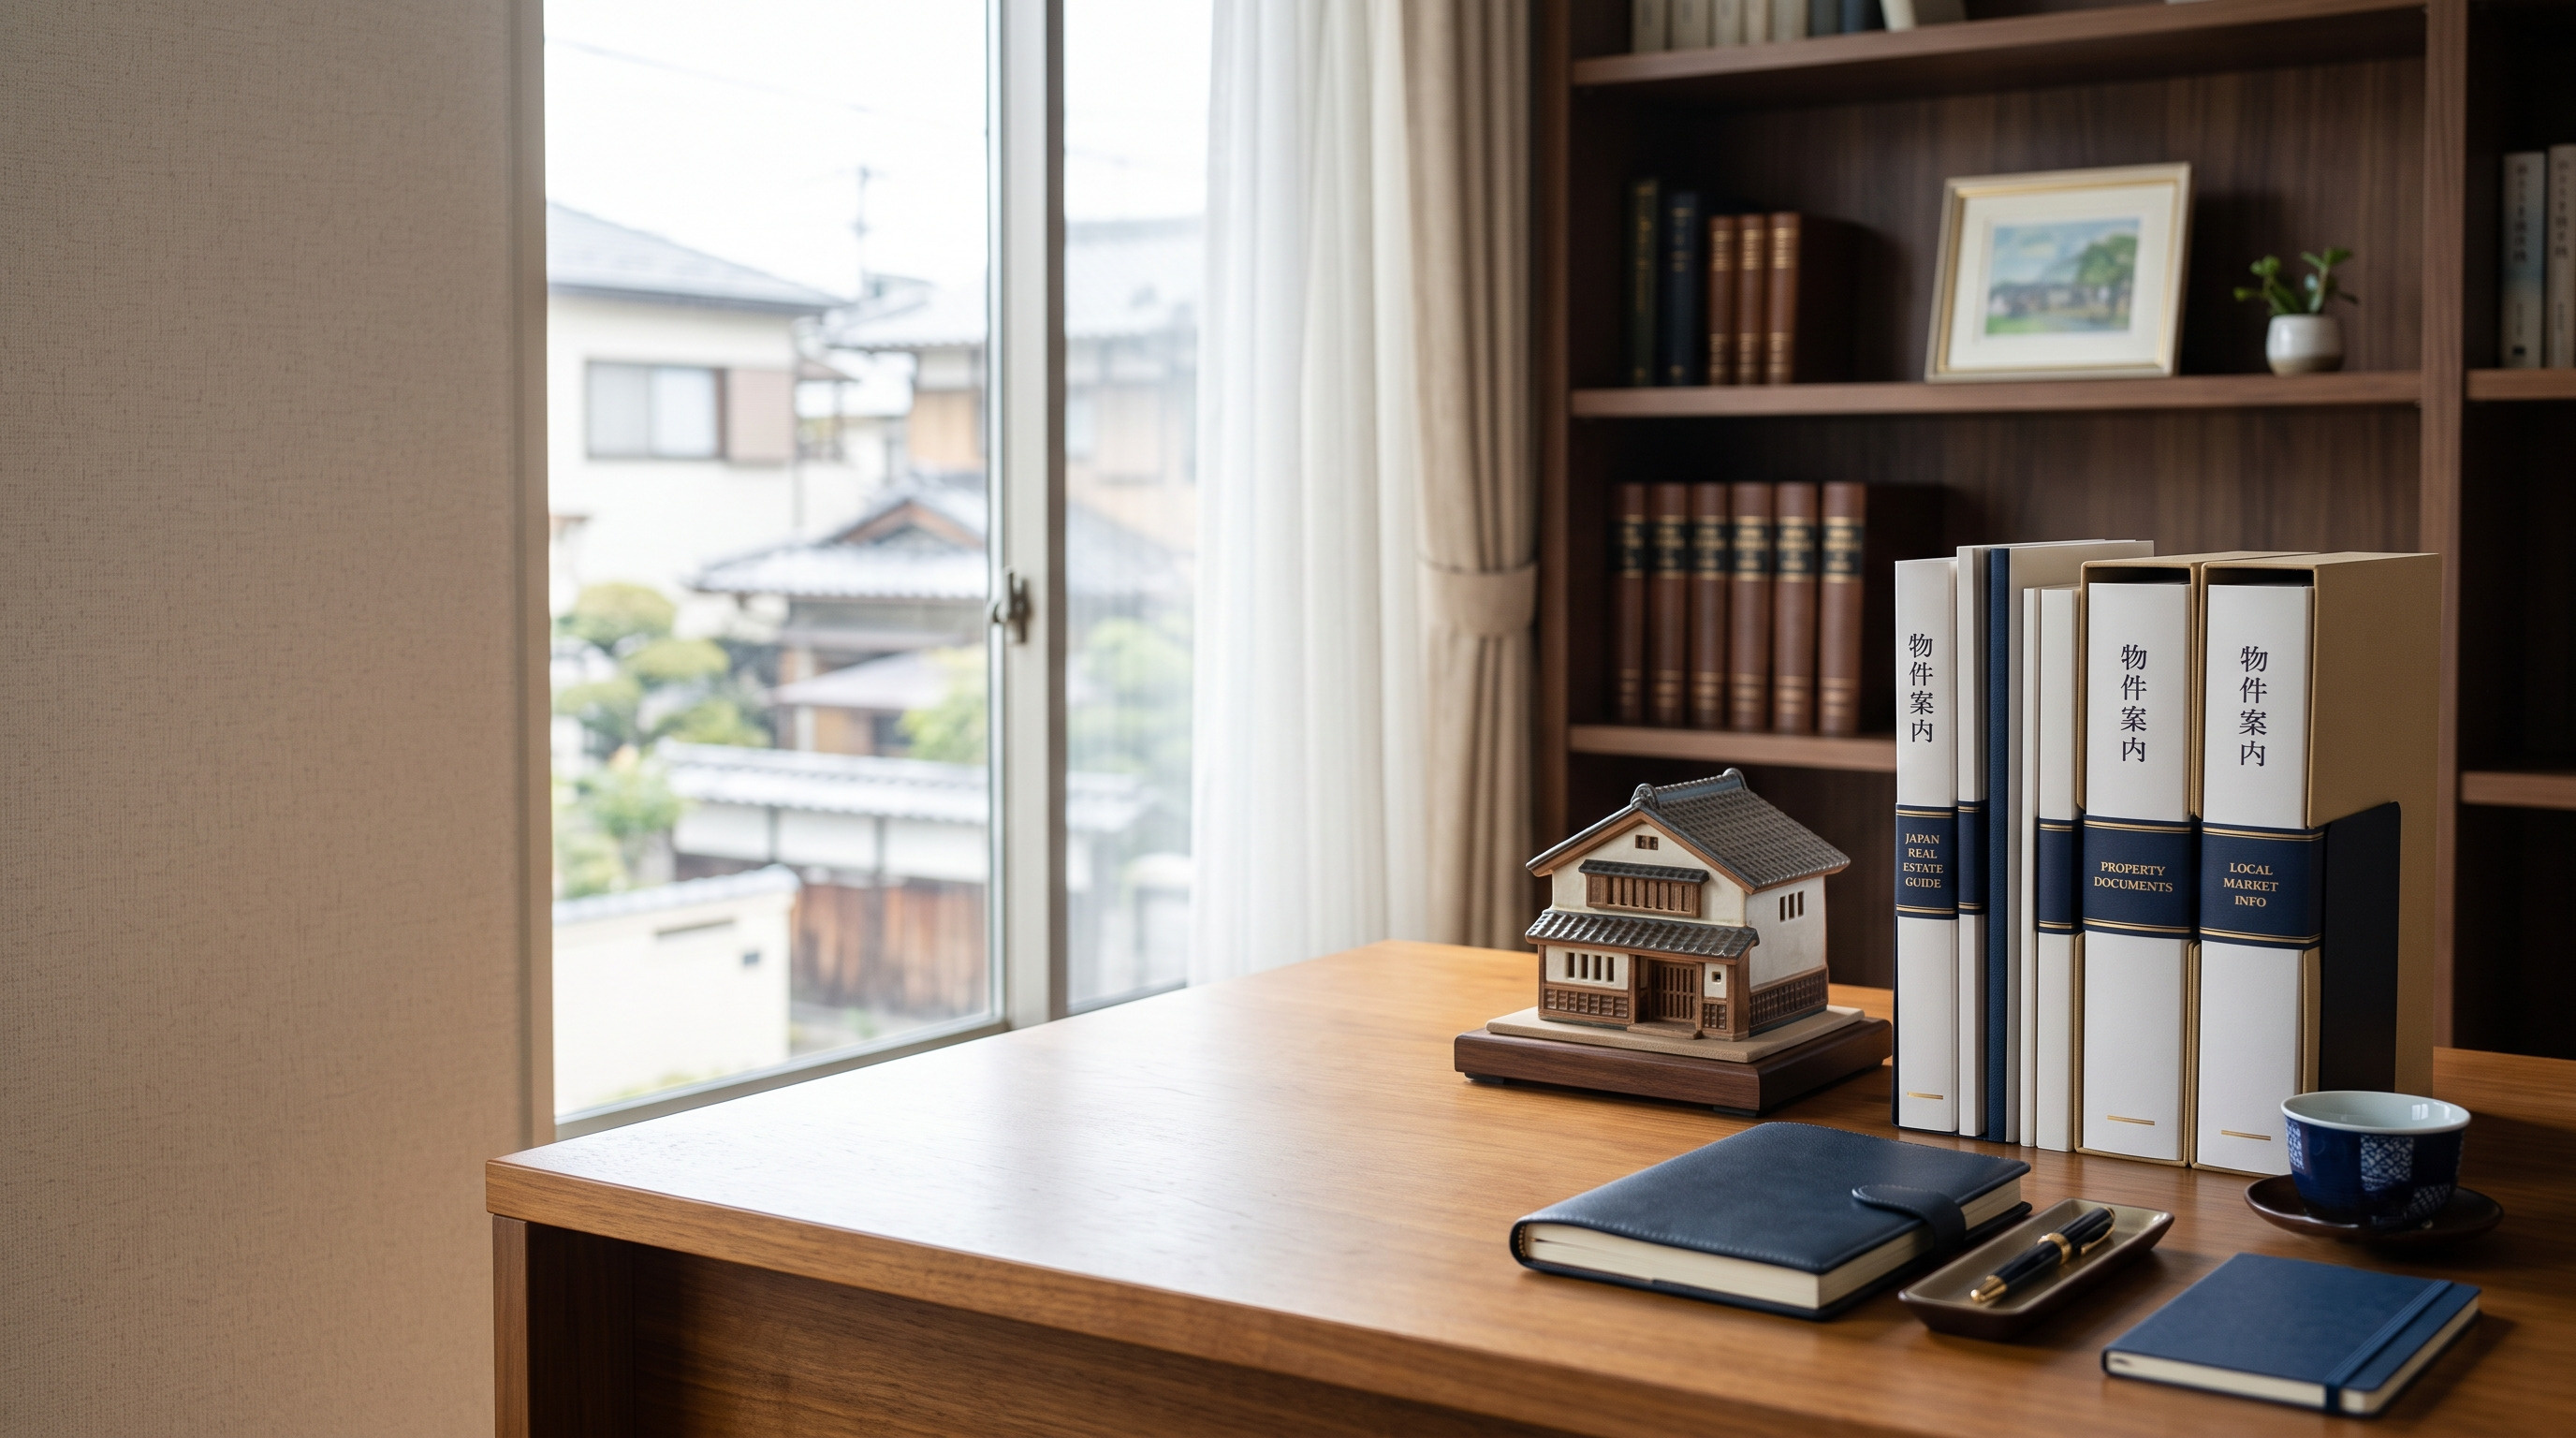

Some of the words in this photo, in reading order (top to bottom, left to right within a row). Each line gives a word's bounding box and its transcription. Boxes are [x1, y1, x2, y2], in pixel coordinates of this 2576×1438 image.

[1909, 633, 1934, 743] 物件案内
[2120, 643, 2147, 763] 物件案内
[2238, 645, 2269, 767] 物件案内
[1905, 833, 1940, 844] JAPAN
[1908, 848, 1938, 858] REAL
[1903, 862, 1944, 873] ESTATE
[2100, 861, 2166, 876] PROPERTY
[2230, 862, 2274, 875] LOCAL
[1905, 876, 1941, 888] GUIDE
[2094, 876, 2174, 893] DOCUMENTS
[2223, 877, 2279, 892] MARKET
[2234, 895, 2267, 907] INFO
